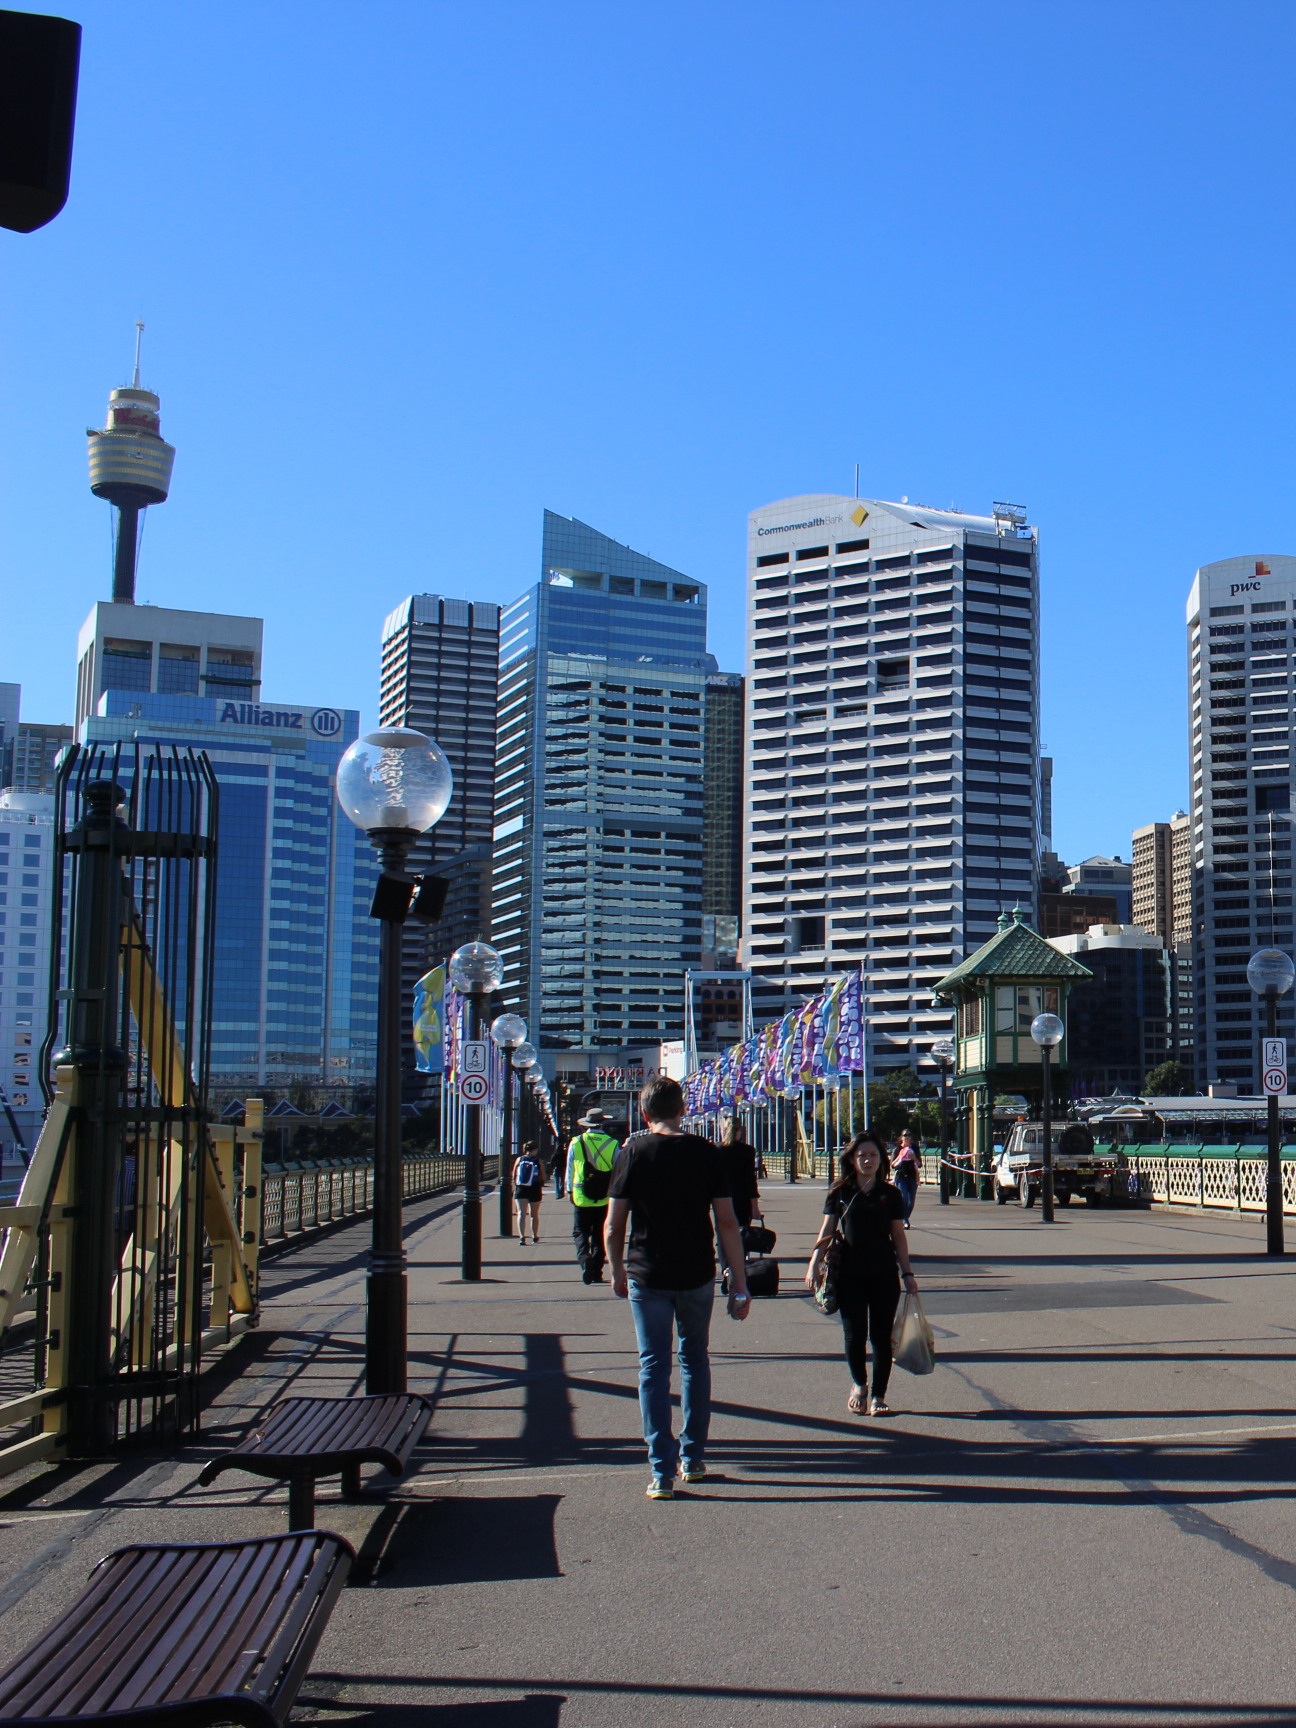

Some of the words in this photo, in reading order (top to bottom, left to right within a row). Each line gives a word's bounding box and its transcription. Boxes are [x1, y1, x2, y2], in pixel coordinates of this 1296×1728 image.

[1230, 581, 1261, 597] pwc
[220, 702, 303, 729] Allianz
[466, 1081, 483, 1094] 10
[1268, 1075, 1282, 1086] 10
